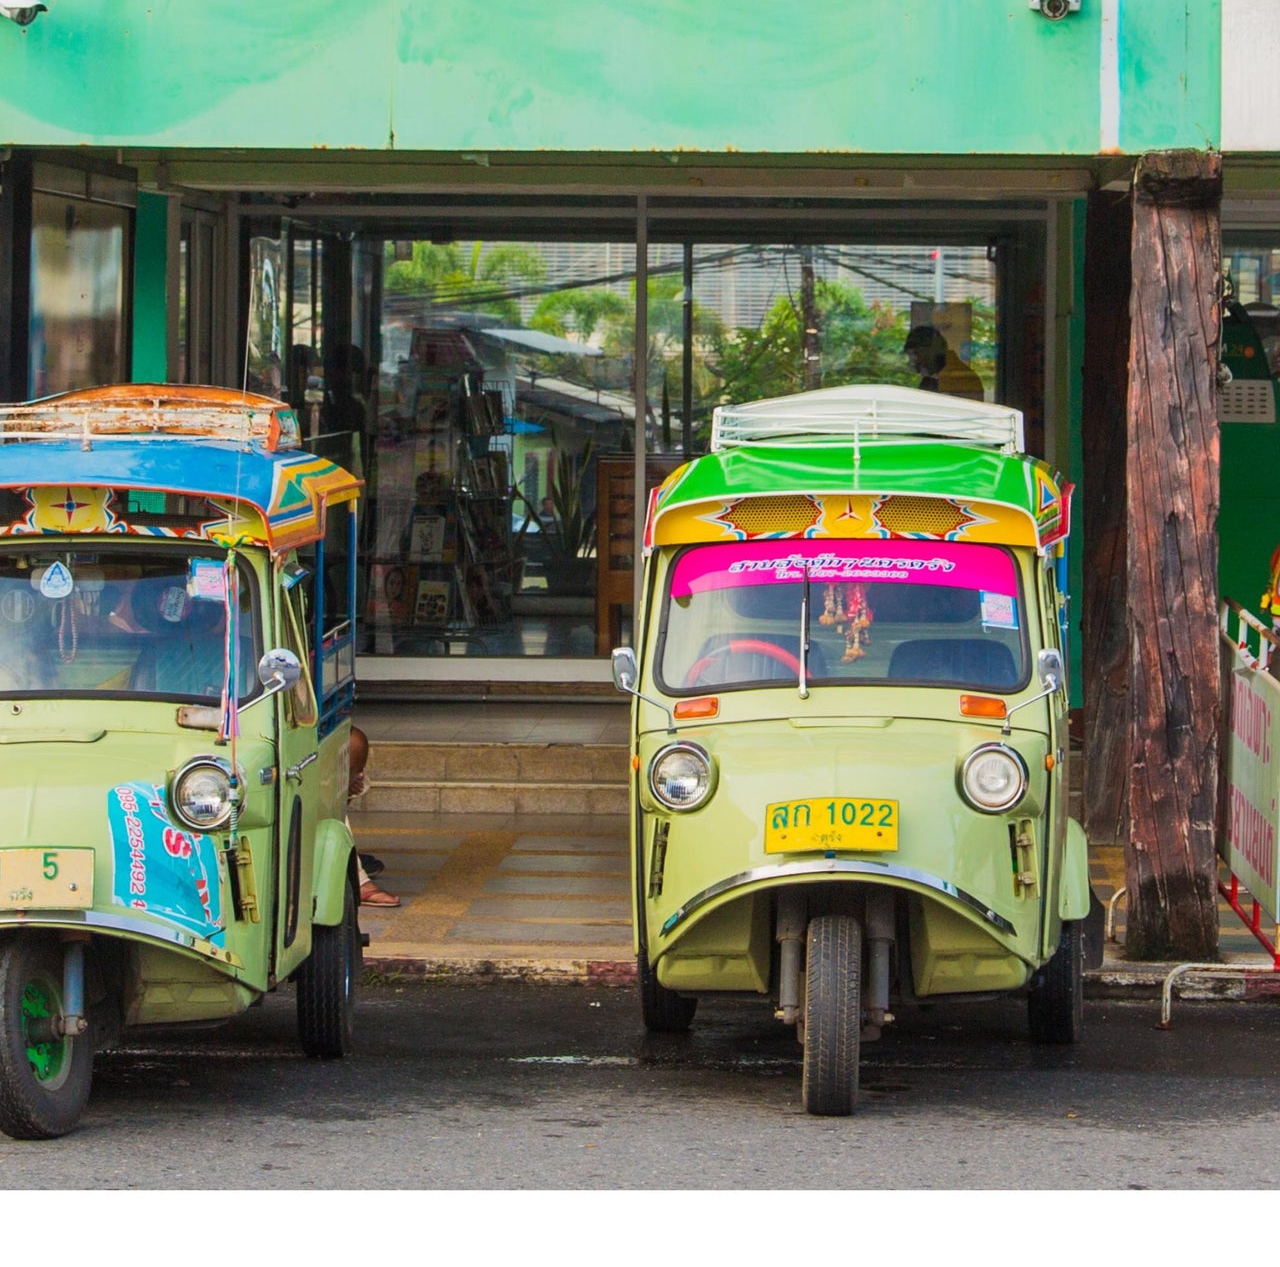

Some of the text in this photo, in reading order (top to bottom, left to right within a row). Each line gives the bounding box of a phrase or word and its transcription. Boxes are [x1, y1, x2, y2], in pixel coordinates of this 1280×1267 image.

[771, 802, 893, 830] สก 1022
[116, 786, 146, 895] 095-2254492
[42, 851, 59, 881] 5
